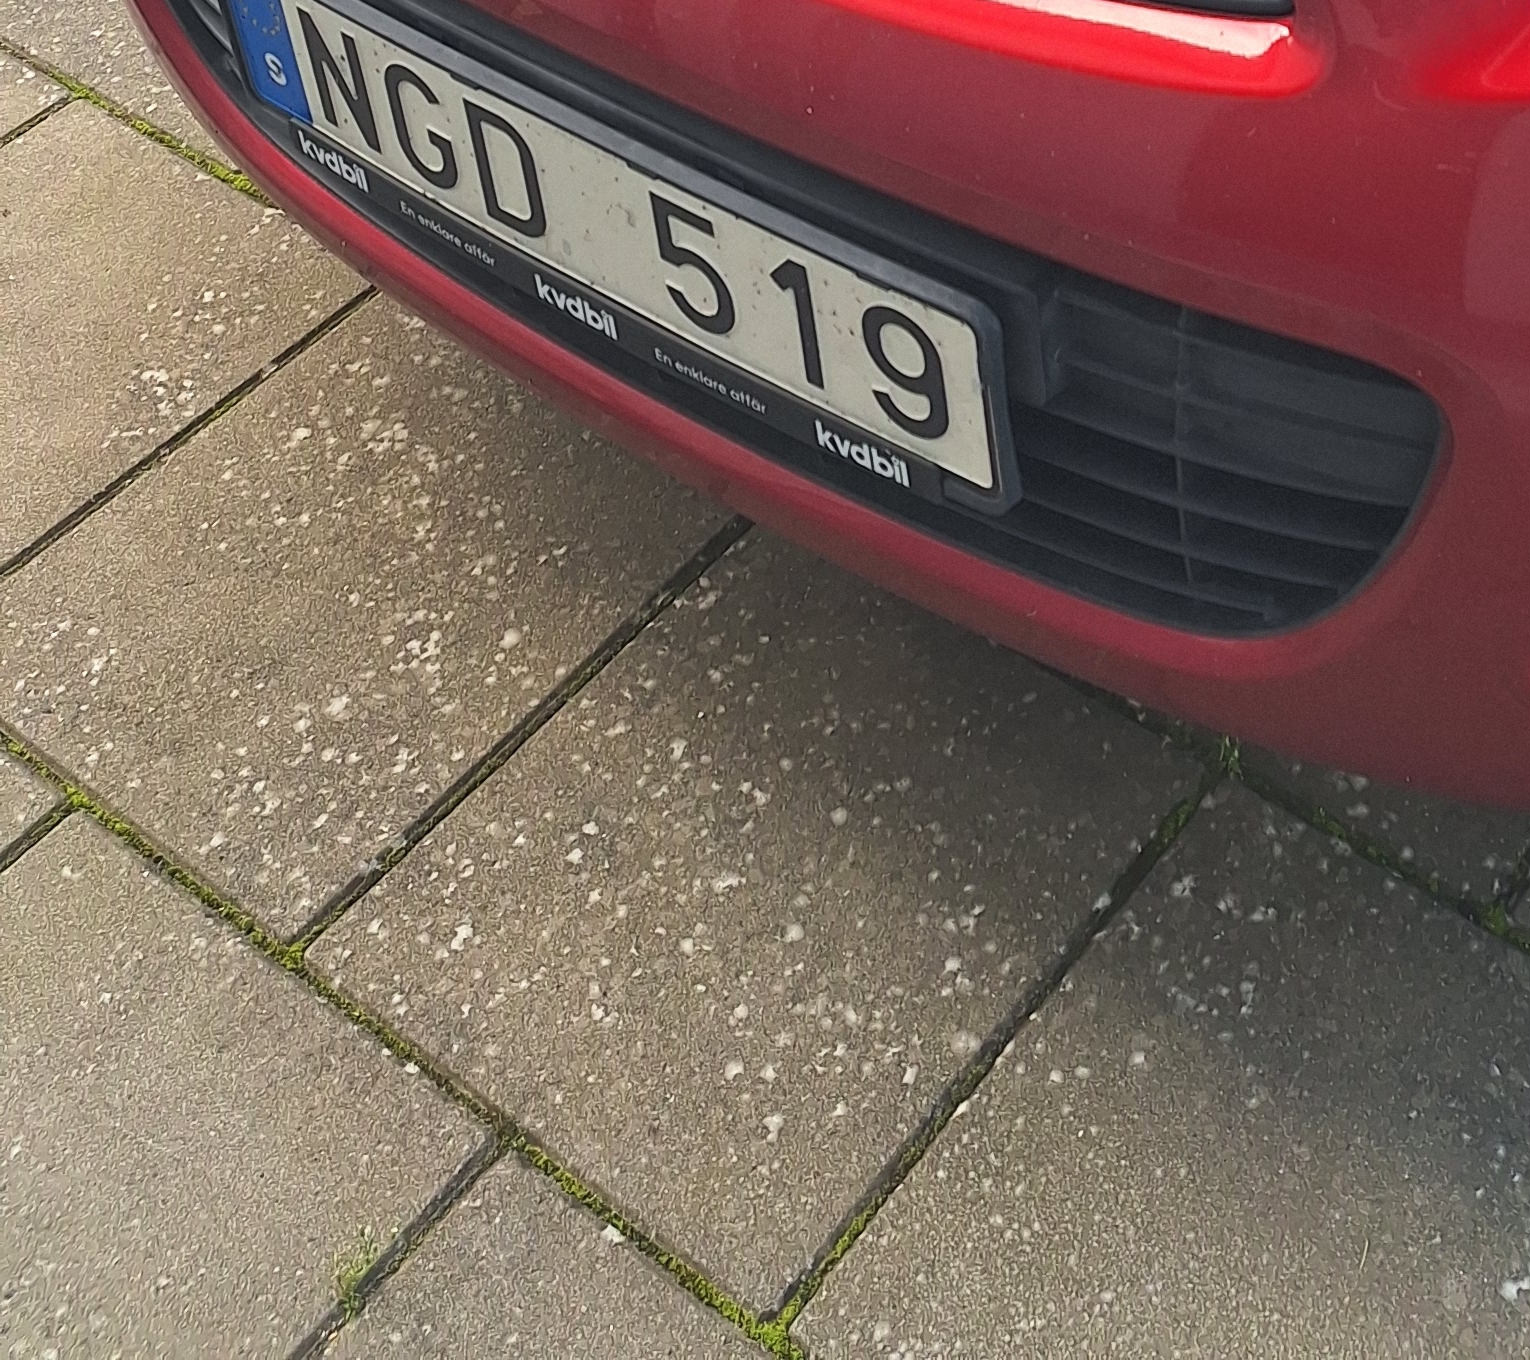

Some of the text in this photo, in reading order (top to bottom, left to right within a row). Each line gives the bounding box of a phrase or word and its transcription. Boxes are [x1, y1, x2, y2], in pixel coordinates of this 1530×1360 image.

[264, 53, 287, 86] S
[298, 130, 369, 193] kvdbil
[296, 6, 949, 440] NGD 519
[400, 201, 415, 219] En
[534, 273, 618, 341] kvdbil
[654, 347, 673, 367] En
[675, 359, 727, 395] enklare
[814, 419, 911, 488] kvdbil
